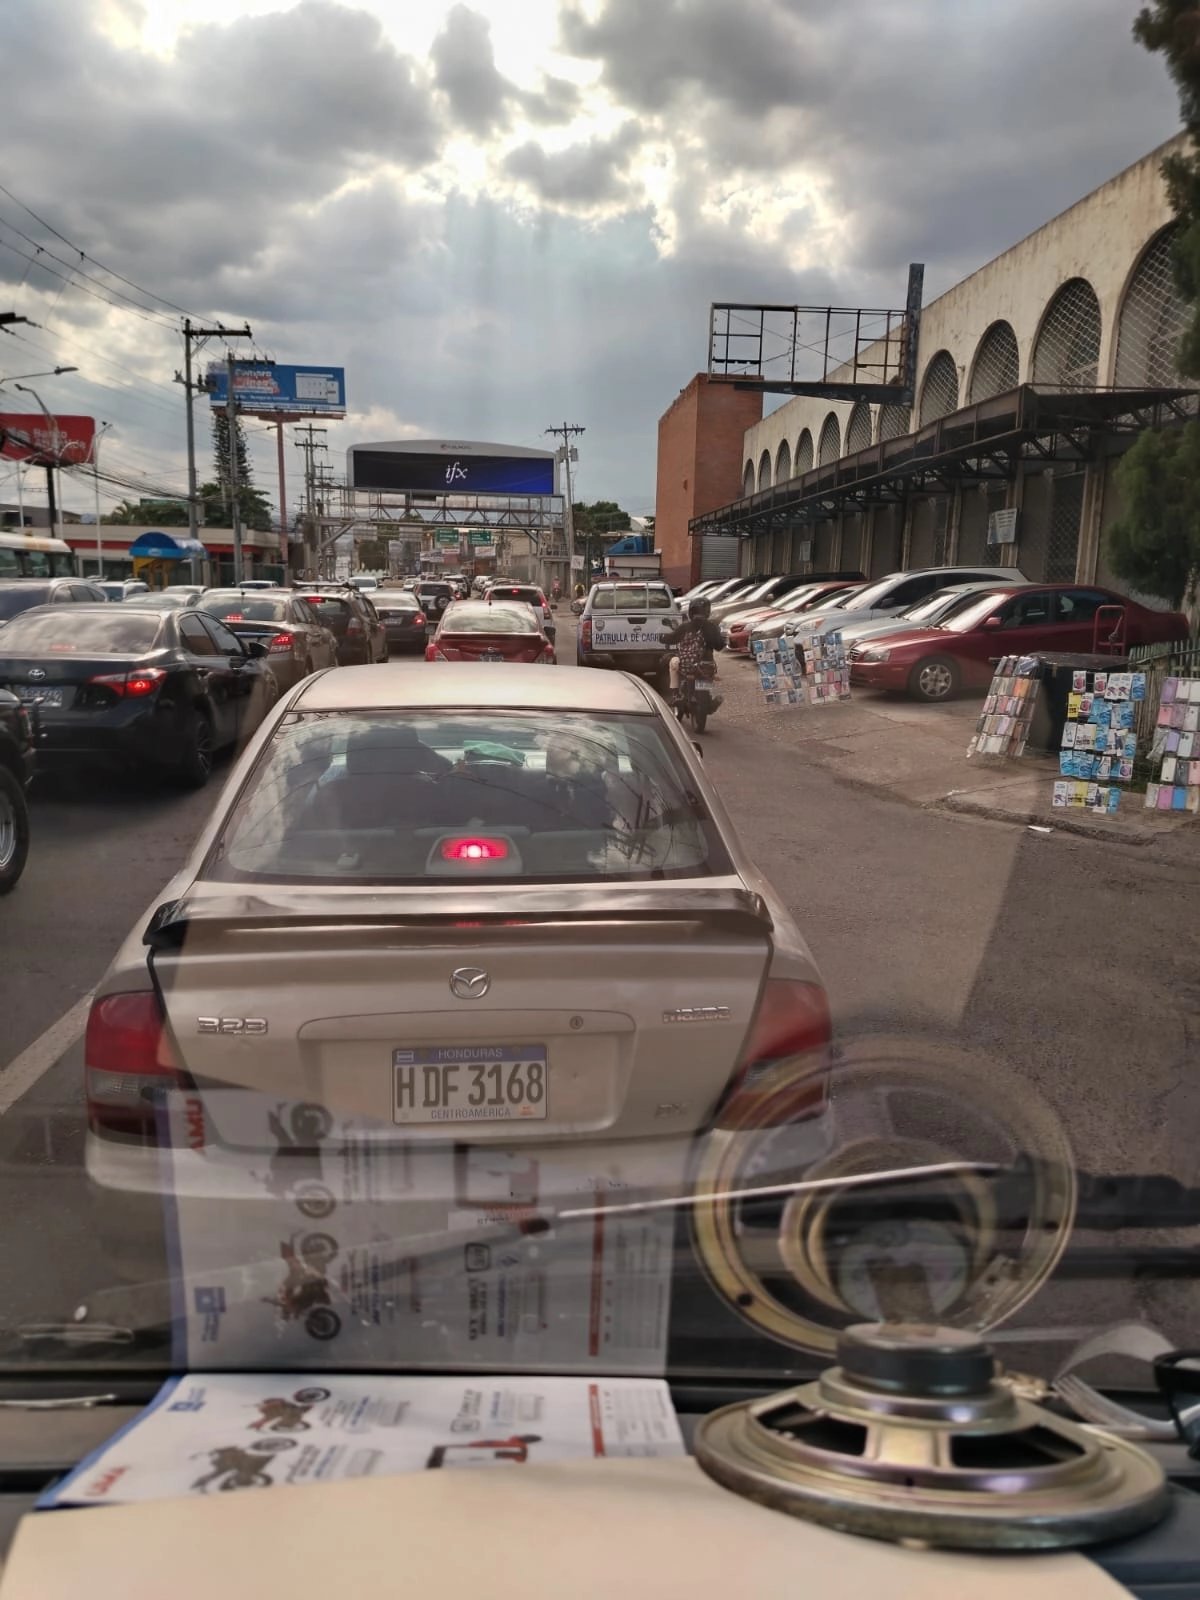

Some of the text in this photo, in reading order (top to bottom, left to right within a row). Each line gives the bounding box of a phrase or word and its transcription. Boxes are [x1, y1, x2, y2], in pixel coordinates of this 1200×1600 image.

[445, 461, 468, 484] ifx
[596, 632, 628, 642] PATRULLA
[630, 633, 640, 642] DE
[197, 1016, 268, 1035] 323
[438, 1047, 503, 1060] HONDURAS
[467, 1062, 544, 1106] 3168
[431, 1107, 511, 1120] CENTROAMERICA
